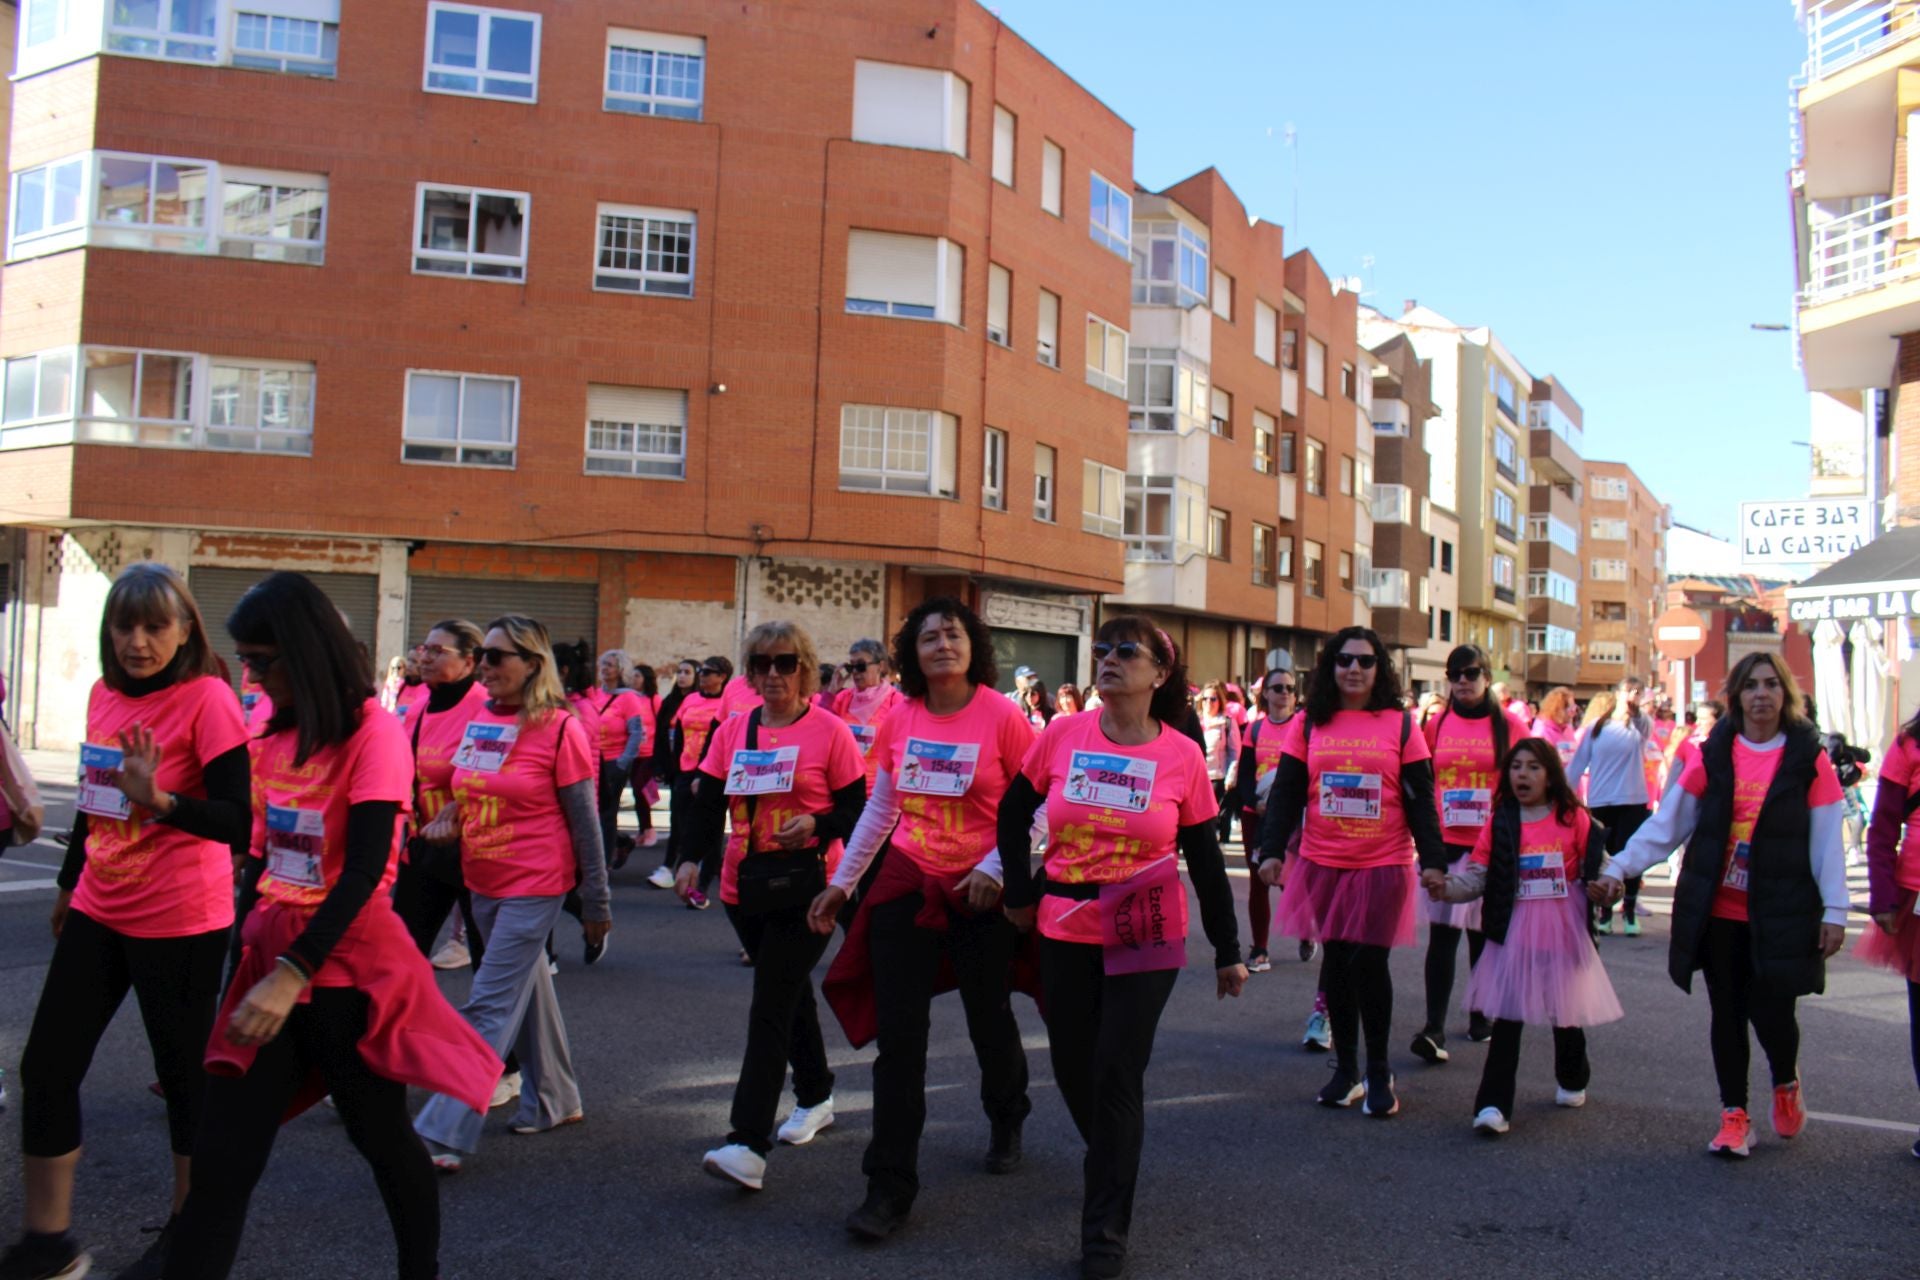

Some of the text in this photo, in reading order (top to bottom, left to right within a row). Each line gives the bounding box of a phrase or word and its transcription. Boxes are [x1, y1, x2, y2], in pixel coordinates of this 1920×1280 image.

[1750, 506, 1859, 527] CAFE BAR
[1745, 537, 1772, 555] LA
[1791, 596, 1831, 620] CAFÉ
[1833, 597, 1870, 618] BAR
[1877, 591, 1907, 615] LA
[931, 759, 962, 773] 1542
[1097, 770, 1136, 788] 2281
[1149, 885, 1167, 949] Ezedent
